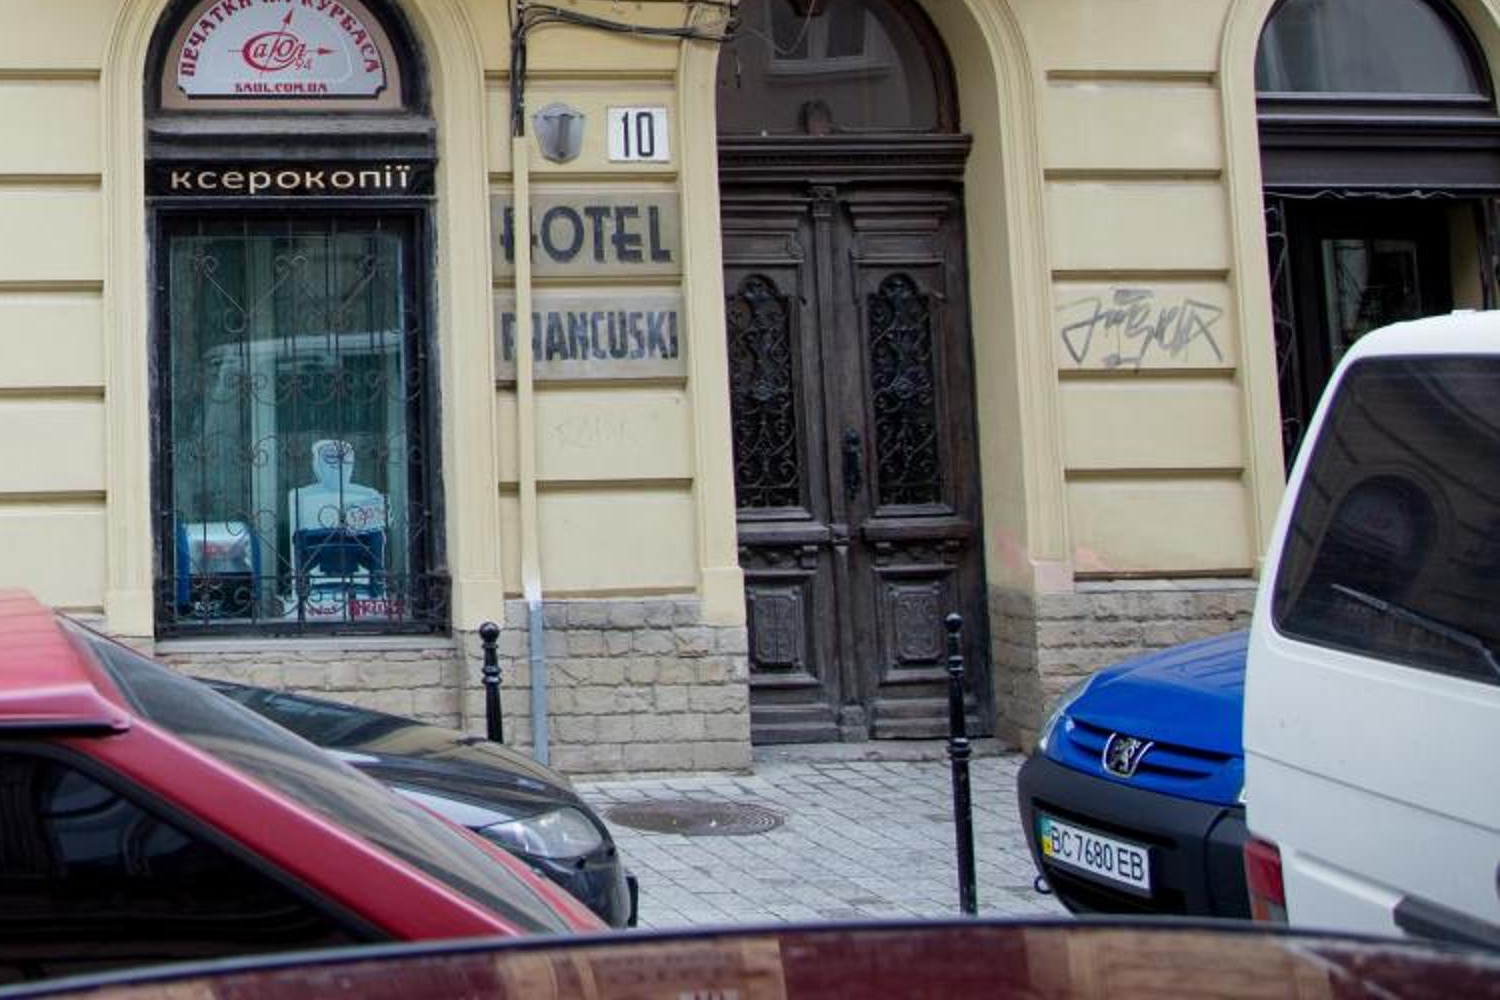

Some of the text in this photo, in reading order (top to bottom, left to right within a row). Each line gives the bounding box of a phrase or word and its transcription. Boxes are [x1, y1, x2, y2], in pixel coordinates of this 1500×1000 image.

[621, 112, 655, 158] 10
[171, 165, 411, 195] ксерокопії
[1051, 826, 1144, 881] BC 7680 EB
